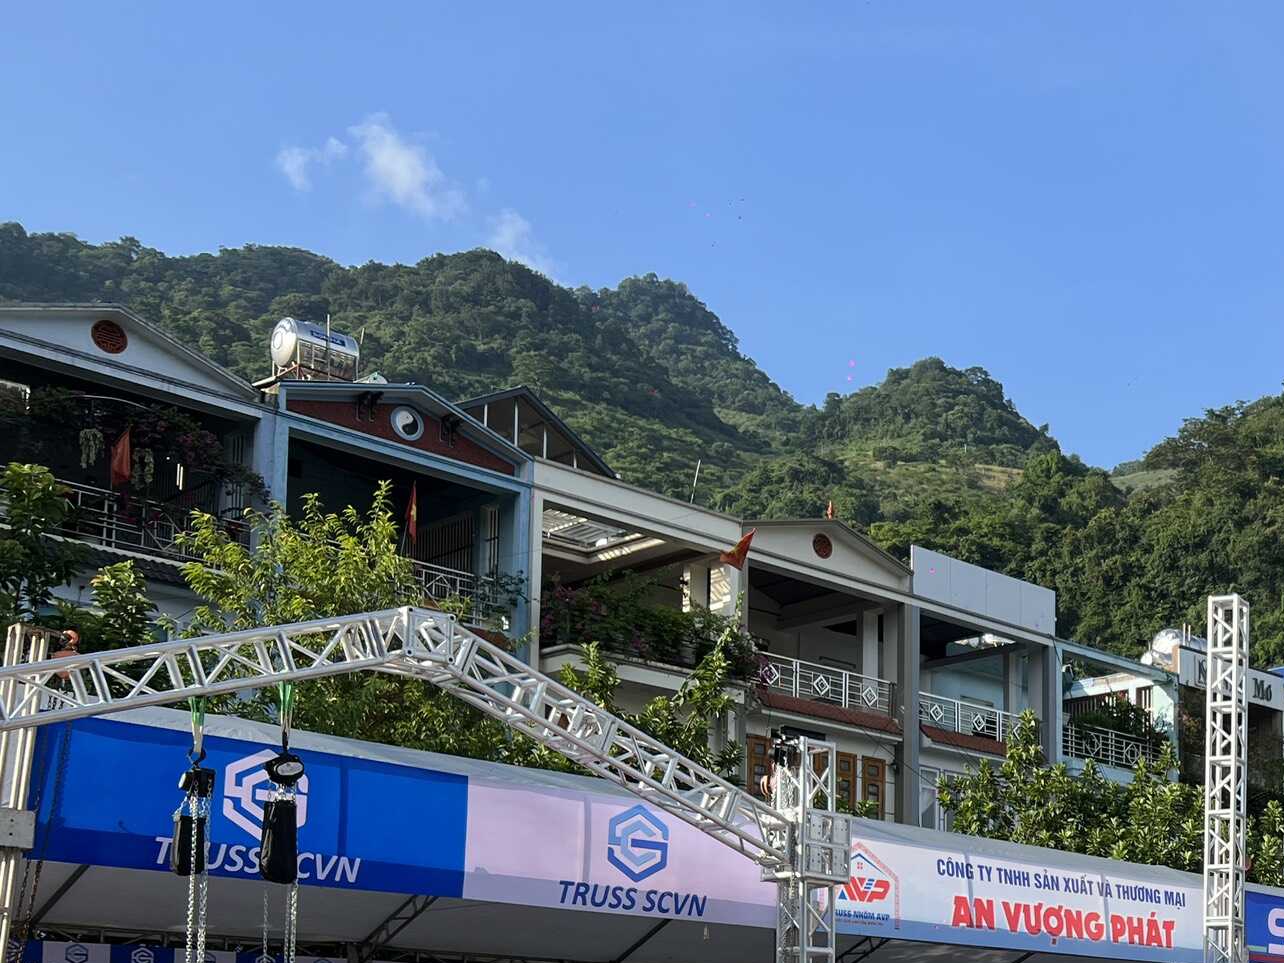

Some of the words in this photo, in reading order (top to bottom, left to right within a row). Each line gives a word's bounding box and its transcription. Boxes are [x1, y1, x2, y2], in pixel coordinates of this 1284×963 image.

[154, 836, 262, 874] TUSS
[296, 855, 361, 883] CVN
[936, 855, 974, 880] CÔNG
[977, 864, 993, 883] TY
[996, 866, 1031, 888] TNHH
[1034, 867, 1060, 891] SẢN
[1063, 871, 1094, 895] XUẤT
[1097, 876, 1113, 898] VÀ
[1115, 881, 1161, 905] THƯƠNG
[1164, 888, 1187, 911] MẠI
[558, 880, 638, 912] TRUSS
[643, 889, 708, 917] SCVN
[835, 909, 852, 918] USS
[951, 895, 995, 931] AN
[1002, 899, 1106, 945] VƯỢNG
[1111, 911, 1176, 949] PHÁT
